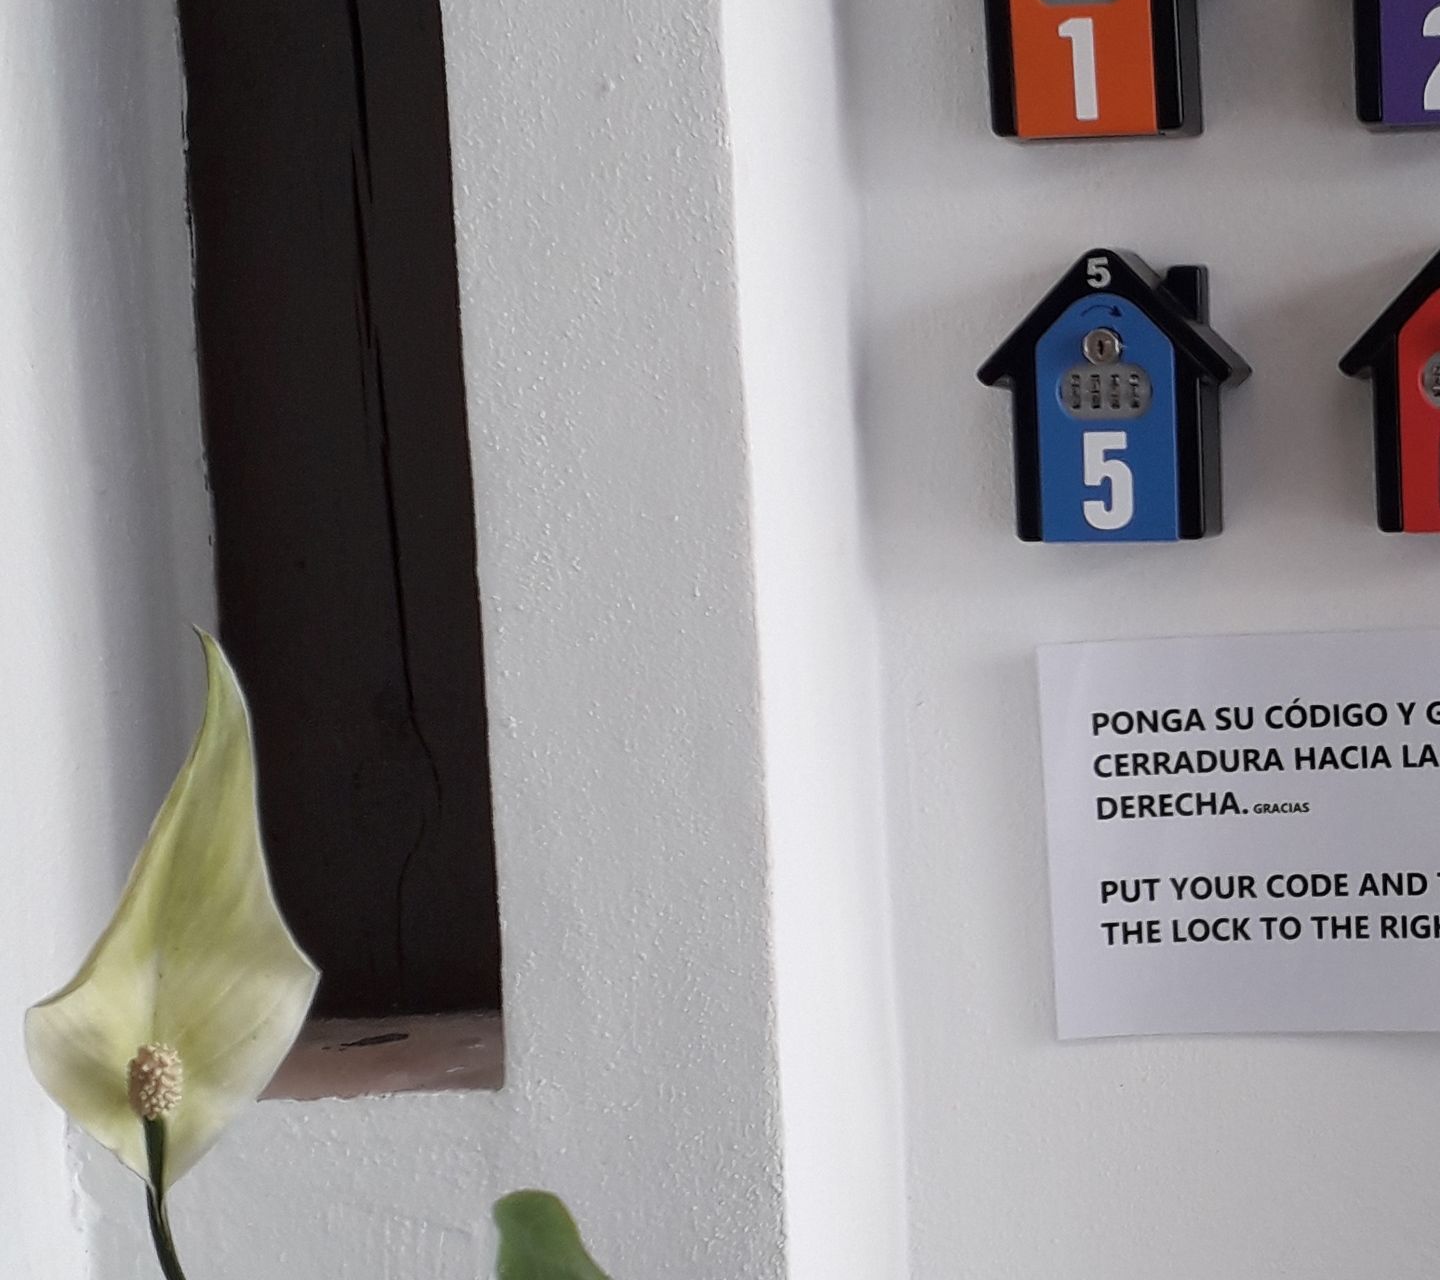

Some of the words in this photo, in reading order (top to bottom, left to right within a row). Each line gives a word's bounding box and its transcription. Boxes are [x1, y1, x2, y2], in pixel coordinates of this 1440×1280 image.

[1058, 17, 1099, 121] 1
[1086, 256, 1112, 289] 5
[1083, 430, 1134, 530] 5
[1092, 708, 1207, 737] PONGA
[1215, 706, 1254, 731] SU
[1264, 697, 1388, 730] CÓDIGO
[1396, 701, 1417, 726] Y
[1093, 747, 1285, 778] CERRADURA
[1294, 744, 1393, 771] HACIA
[1402, 743, 1440, 769] LA
[1096, 791, 1249, 820] DERECHA.
[1253, 802, 1310, 815] GRACIAS
[1100, 878, 1161, 904] PUT
[1169, 875, 1258, 901] YOUR
[1266, 873, 1350, 899] CODE
[1358, 872, 1428, 897] AND
[1100, 919, 1162, 946] THE
[1172, 917, 1252, 943] LOCK
[1259, 915, 1302, 941] TO
[1310, 915, 1371, 940] THE
